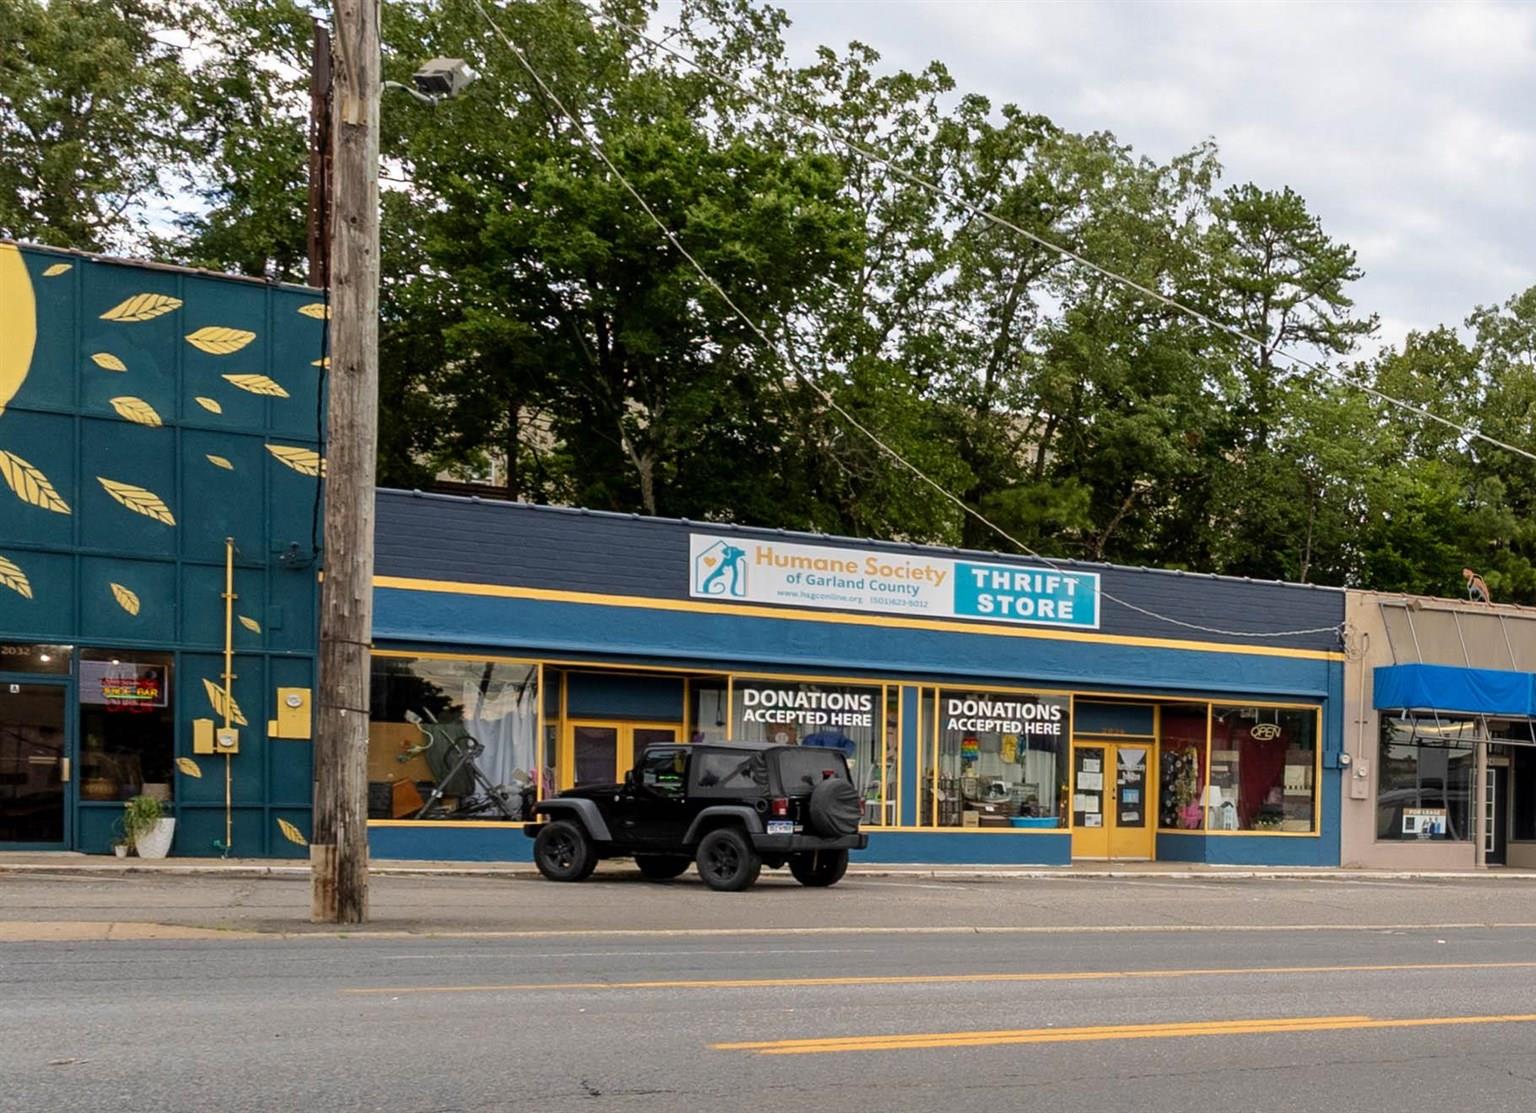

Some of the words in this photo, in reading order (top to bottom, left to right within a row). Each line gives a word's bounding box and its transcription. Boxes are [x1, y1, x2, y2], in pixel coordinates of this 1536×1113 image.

[755, 545, 858, 574] Humane
[865, 557, 946, 587] Society
[786, 572, 801, 585] of
[806, 574, 864, 590] Garland
[869, 579, 920, 597] County
[971, 568, 1079, 597] THRIFT
[976, 593, 1074, 620] STORE
[0, 645, 32, 657] 2032
[743, 688, 872, 712] DONATIONS
[948, 699, 1062, 721] DONATIONS
[743, 709, 828, 725] ACCEPTED
[831, 712, 873, 728] HERE
[947, 717, 1022, 734] ACCEPTED
[1025, 721, 1062, 736] HERE
[1250, 724, 1282, 740] OPEN
